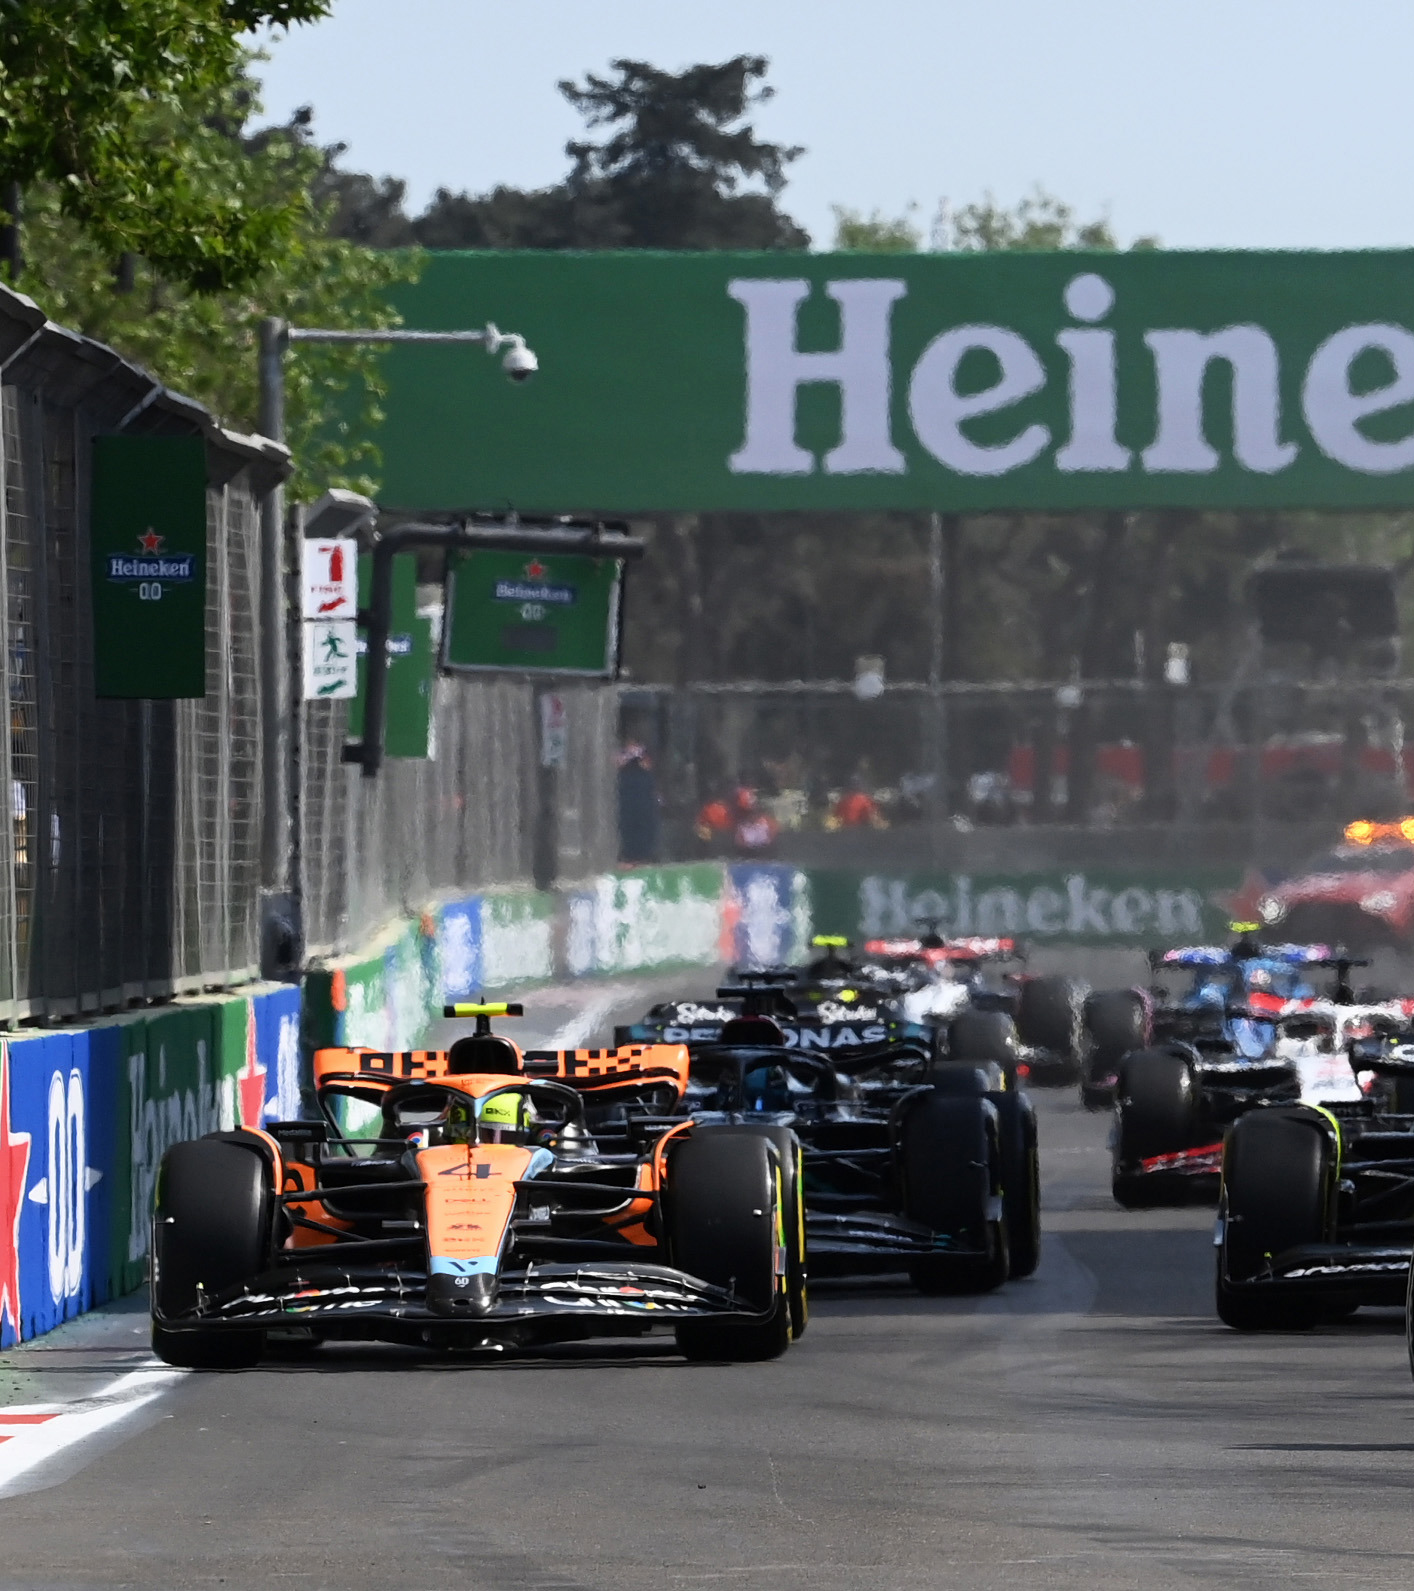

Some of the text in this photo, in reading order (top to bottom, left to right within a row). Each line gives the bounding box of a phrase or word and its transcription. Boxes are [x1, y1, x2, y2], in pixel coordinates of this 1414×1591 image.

[110, 557, 190, 577] Heineken
[857, 872, 1202, 935] Heineken
[438, 1162, 502, 1180] 4
